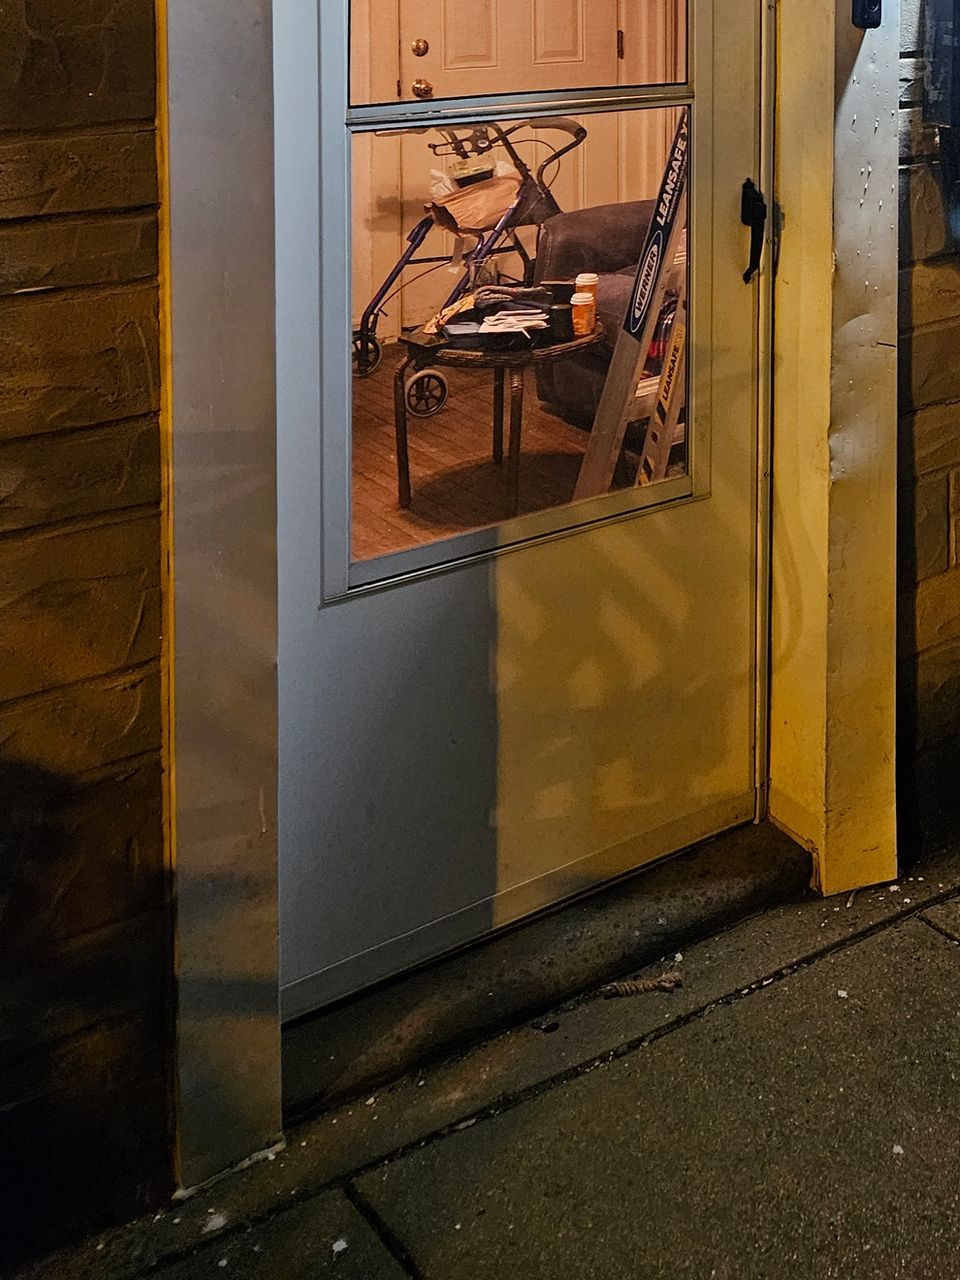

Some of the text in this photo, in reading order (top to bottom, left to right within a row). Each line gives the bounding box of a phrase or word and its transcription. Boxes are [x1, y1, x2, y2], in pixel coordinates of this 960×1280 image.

[656, 137, 688, 227] LEANSAFE
[634, 247, 658, 313] WERNER
[662, 344, 680, 402] LEANSAFE
